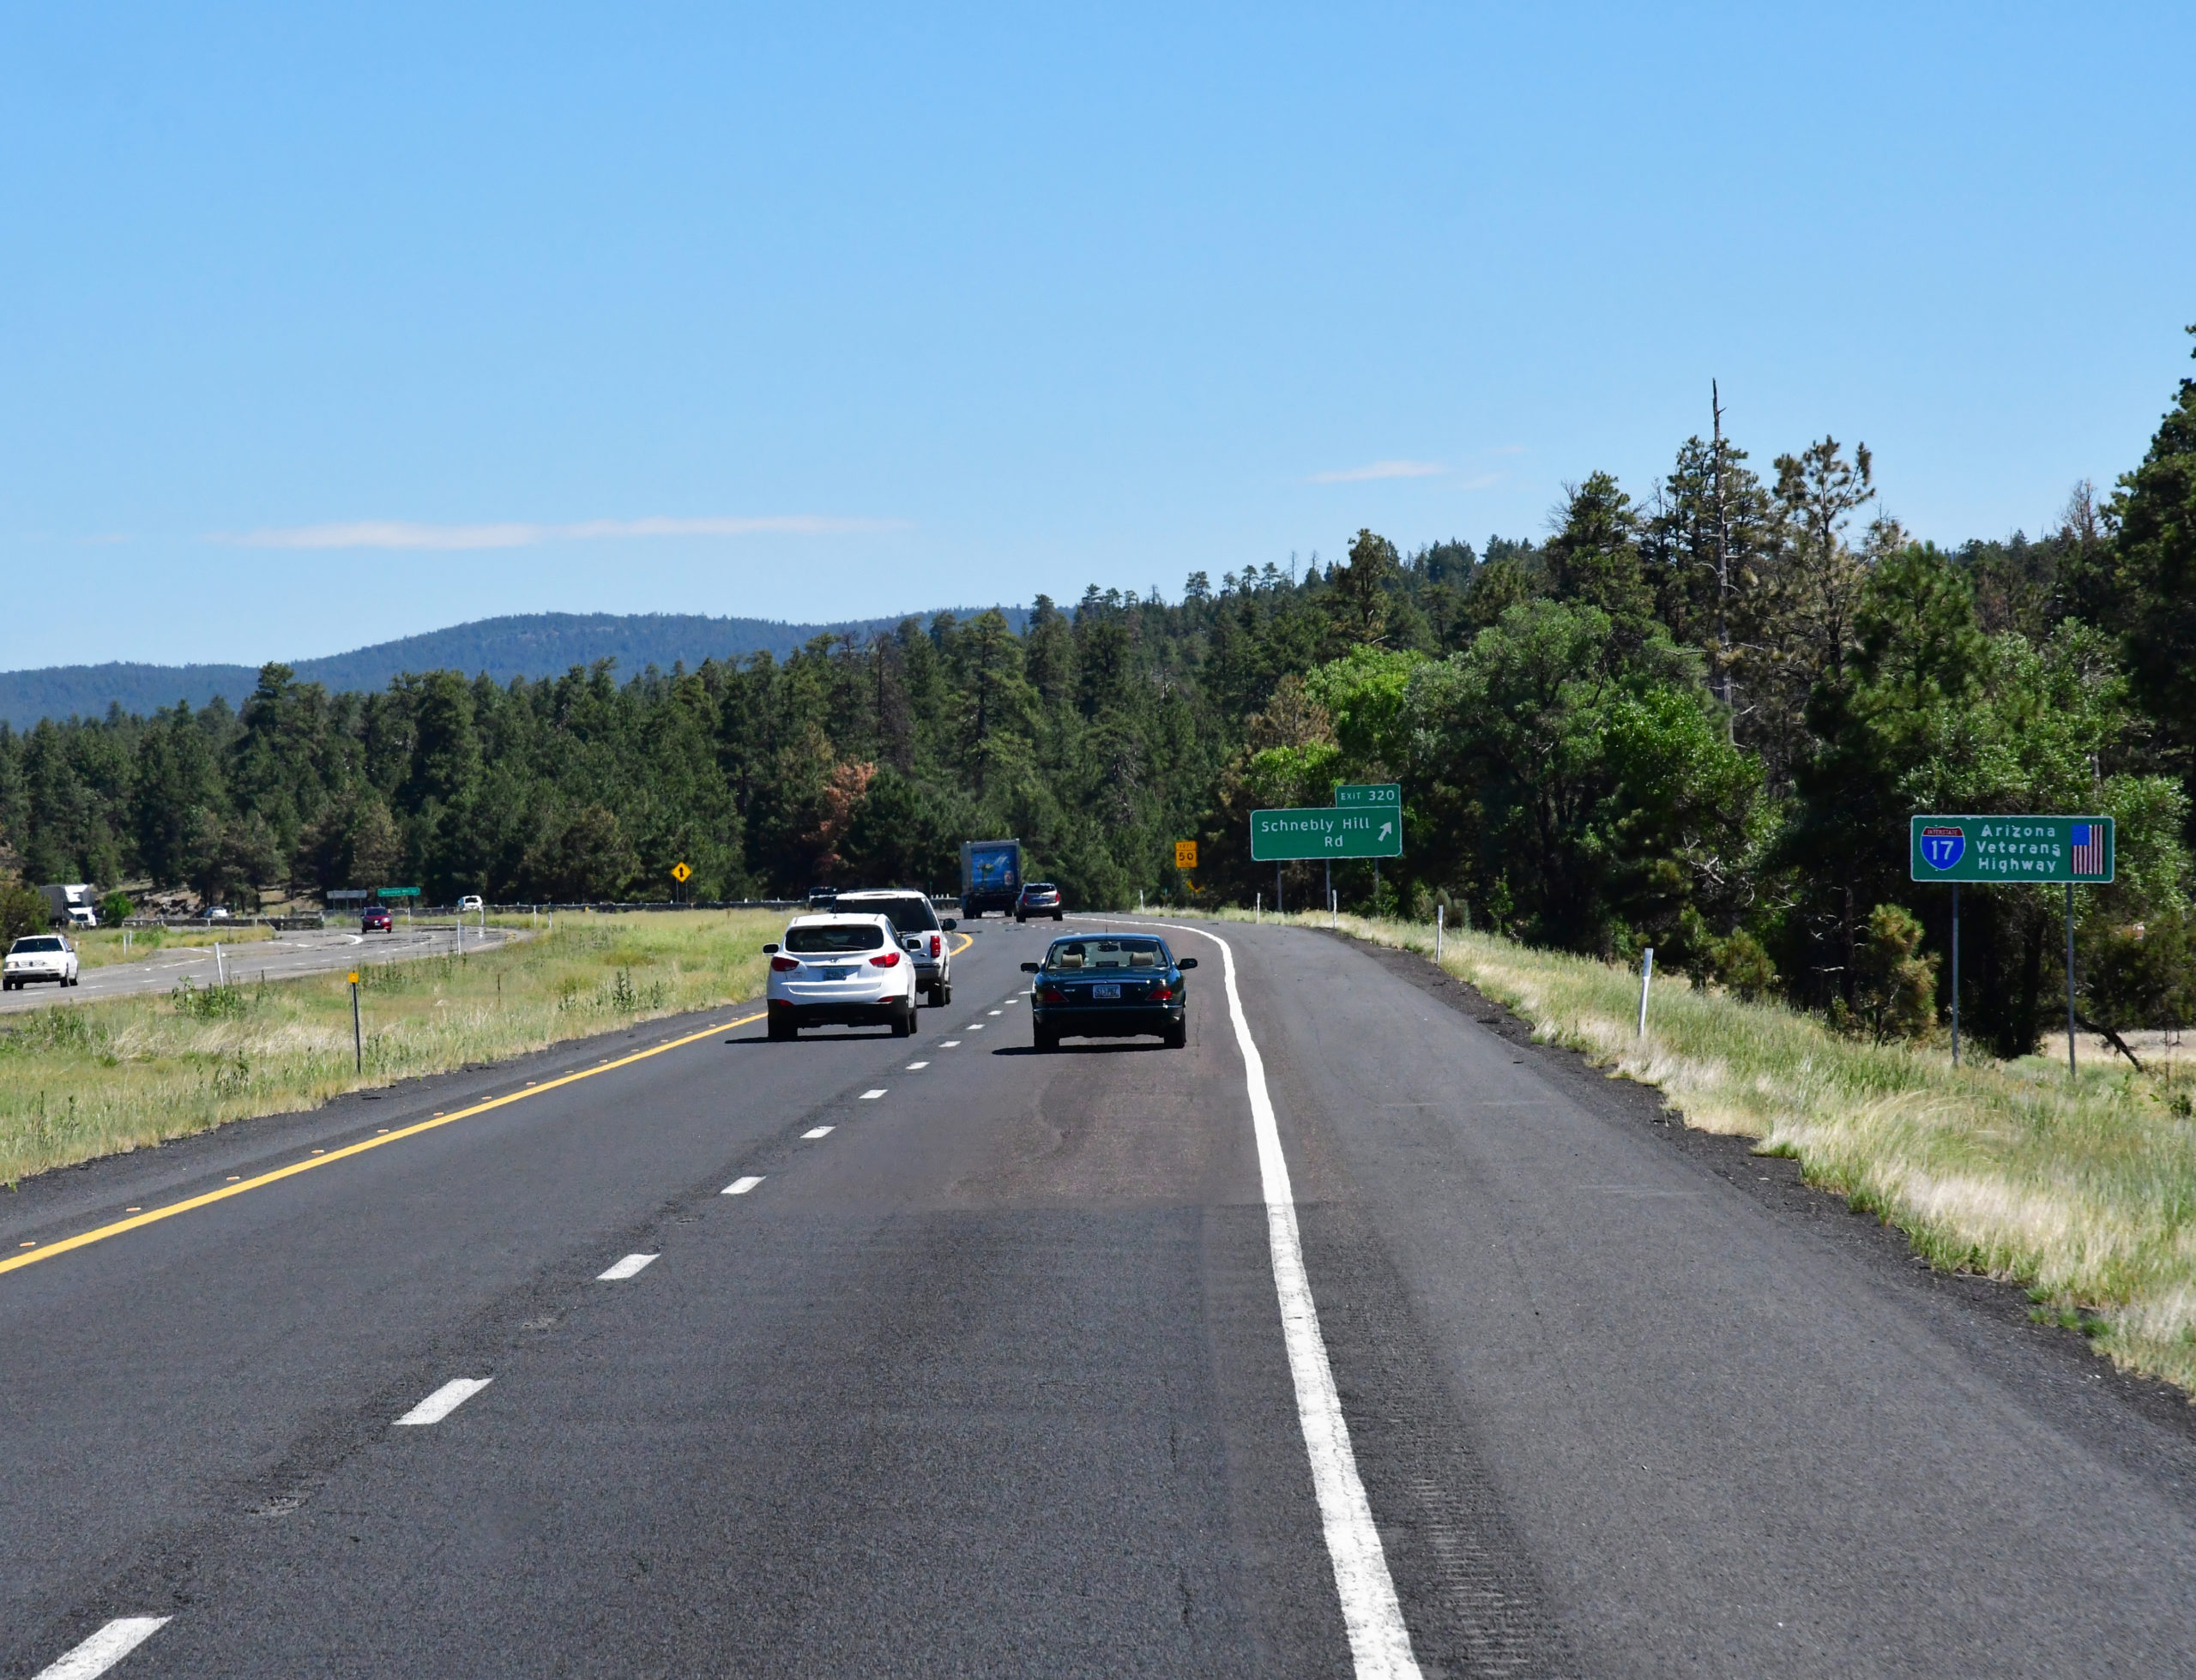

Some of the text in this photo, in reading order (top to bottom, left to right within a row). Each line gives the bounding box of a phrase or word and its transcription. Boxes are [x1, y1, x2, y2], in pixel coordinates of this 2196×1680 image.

[1340, 790, 1395, 801] EXIT 320
[1261, 816, 1370, 833] Schnebly Hill
[1981, 824, 2055, 837] Arizona
[1324, 834, 1343, 847] Rd
[1976, 840, 2061, 855] Veterans
[1179, 852, 1194, 861] 50
[1931, 840, 1954, 860] 17
[1978, 857, 2057, 873] Highway
